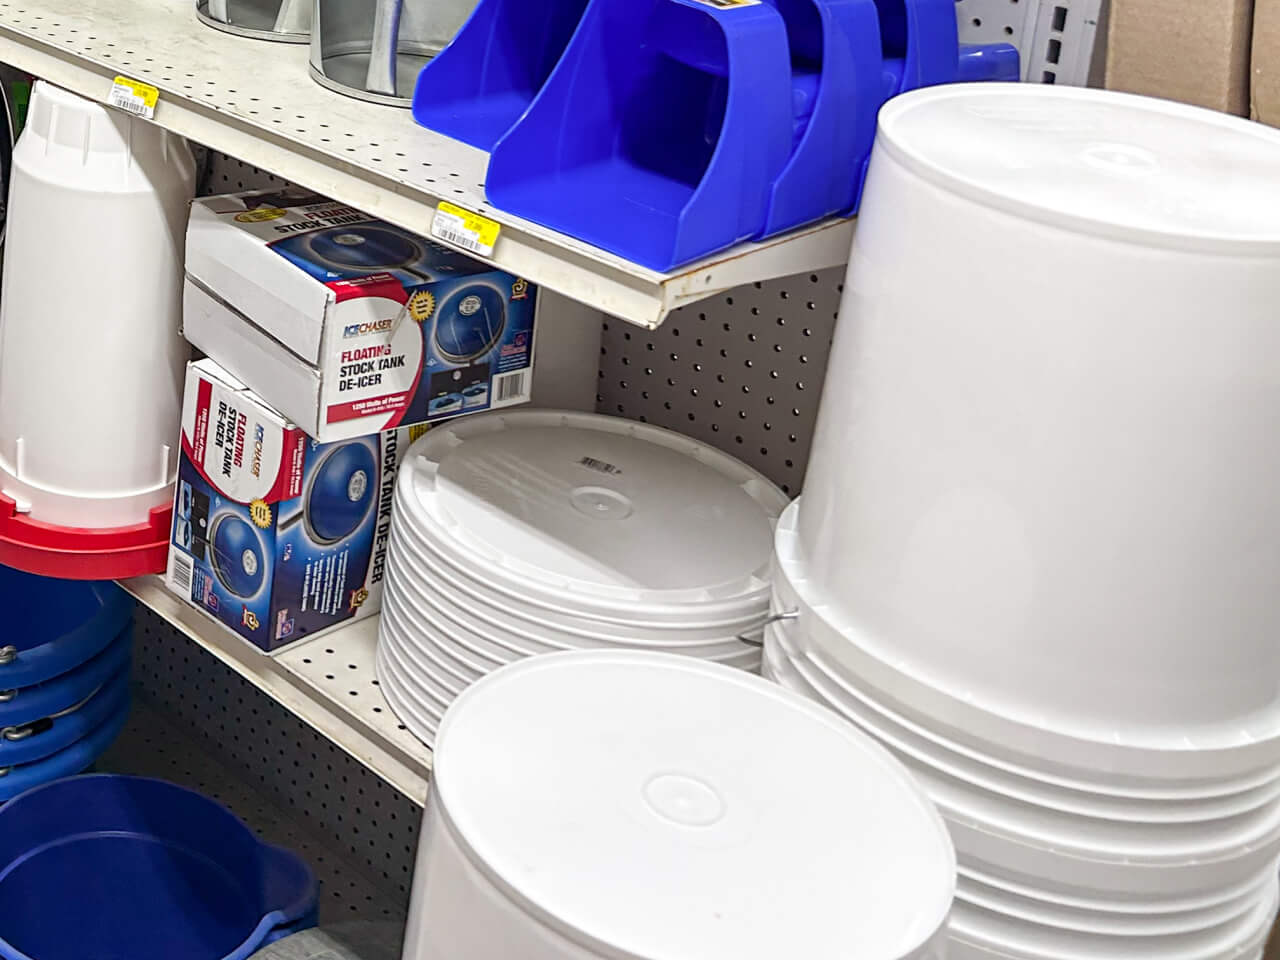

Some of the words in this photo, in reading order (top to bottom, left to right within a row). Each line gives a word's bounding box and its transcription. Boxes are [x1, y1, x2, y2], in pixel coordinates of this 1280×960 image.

[274, 219, 325, 234] STOCK
[326, 214, 365, 226] TANK
[344, 320, 393, 337] ICECHASER
[340, 362, 374, 378] STOCK
[378, 355, 405, 370] TANK
[341, 344, 391, 363] FLOATING
[339, 373, 382, 391] DE-ICER
[215, 401, 228, 448] DE-ICER
[225, 406, 237, 446] STOCK
[233, 412, 247, 469] FLOATING
[222, 447, 233, 478] TANK
[379, 476, 394, 519] TANK
[371, 522, 390, 585] DE-ICER
